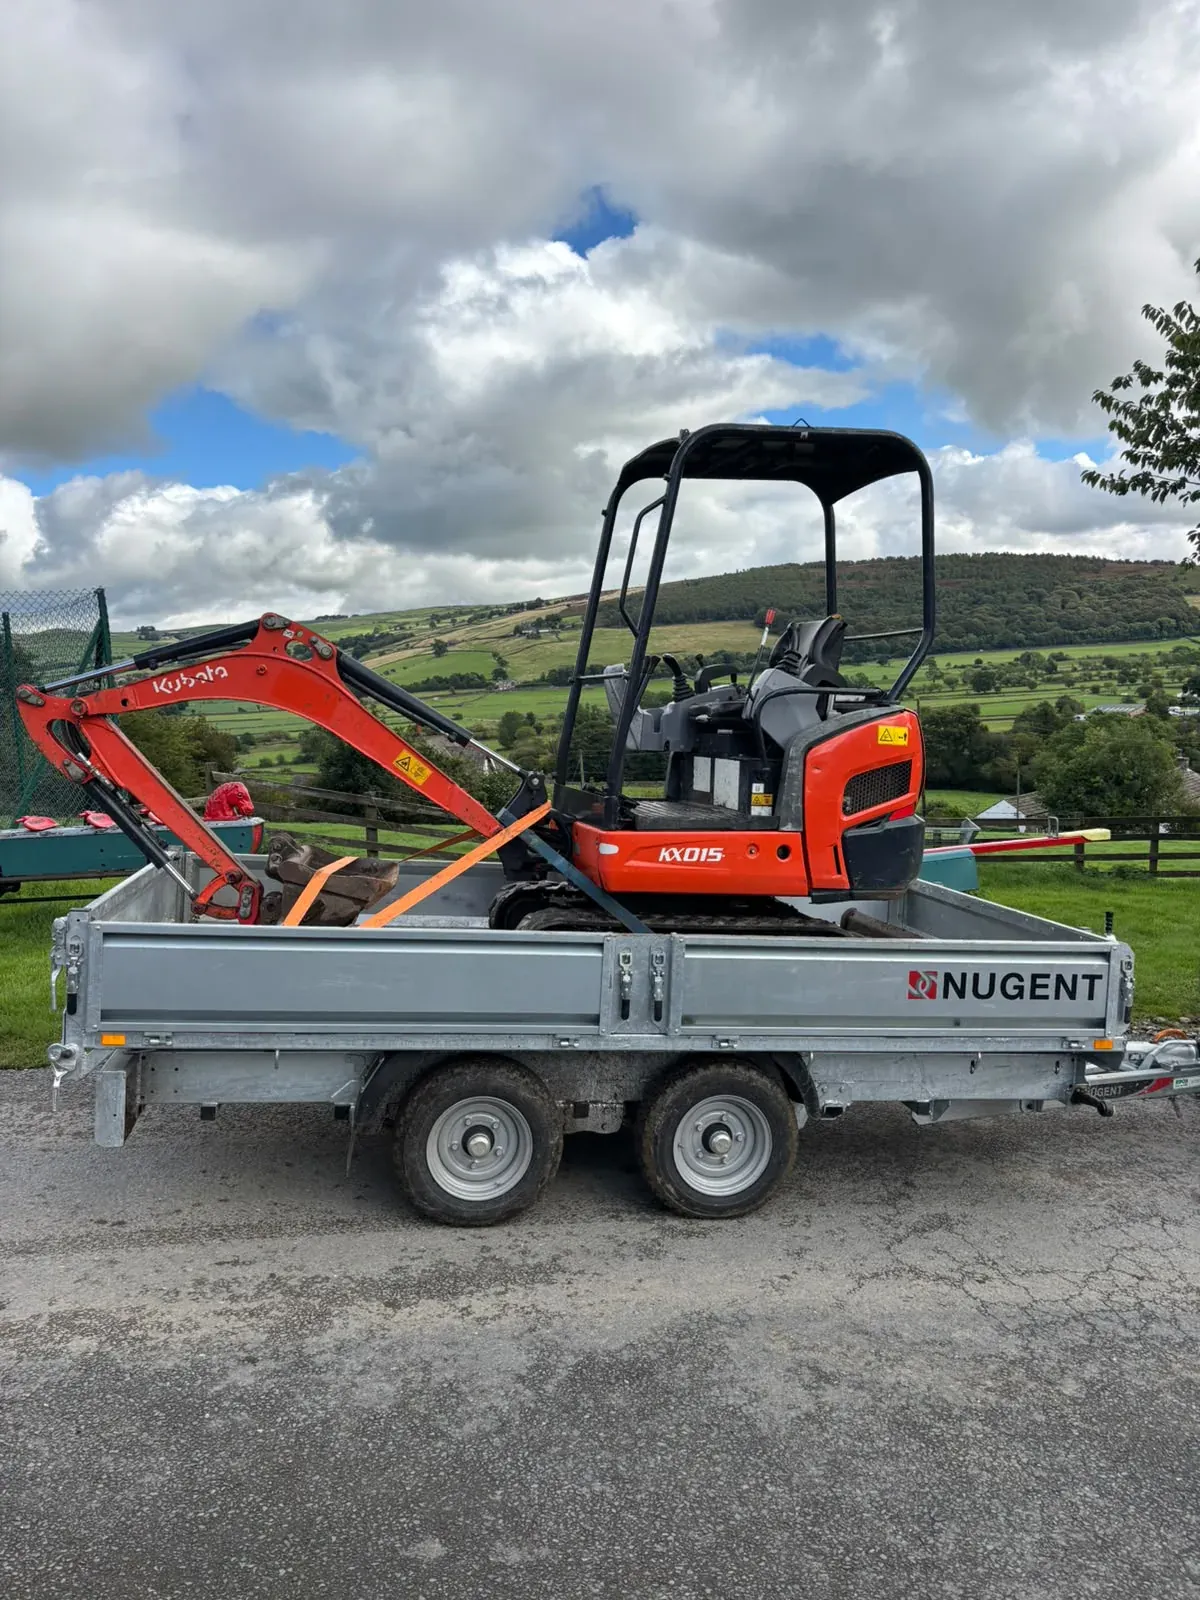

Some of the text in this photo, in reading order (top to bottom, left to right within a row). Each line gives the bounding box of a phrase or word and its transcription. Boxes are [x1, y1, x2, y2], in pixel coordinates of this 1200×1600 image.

[152, 665, 228, 694] Kubota
[658, 847, 724, 862] KX015
[942, 972, 1103, 1001] NUGENT
[1087, 1085, 1123, 1097] UGENT
